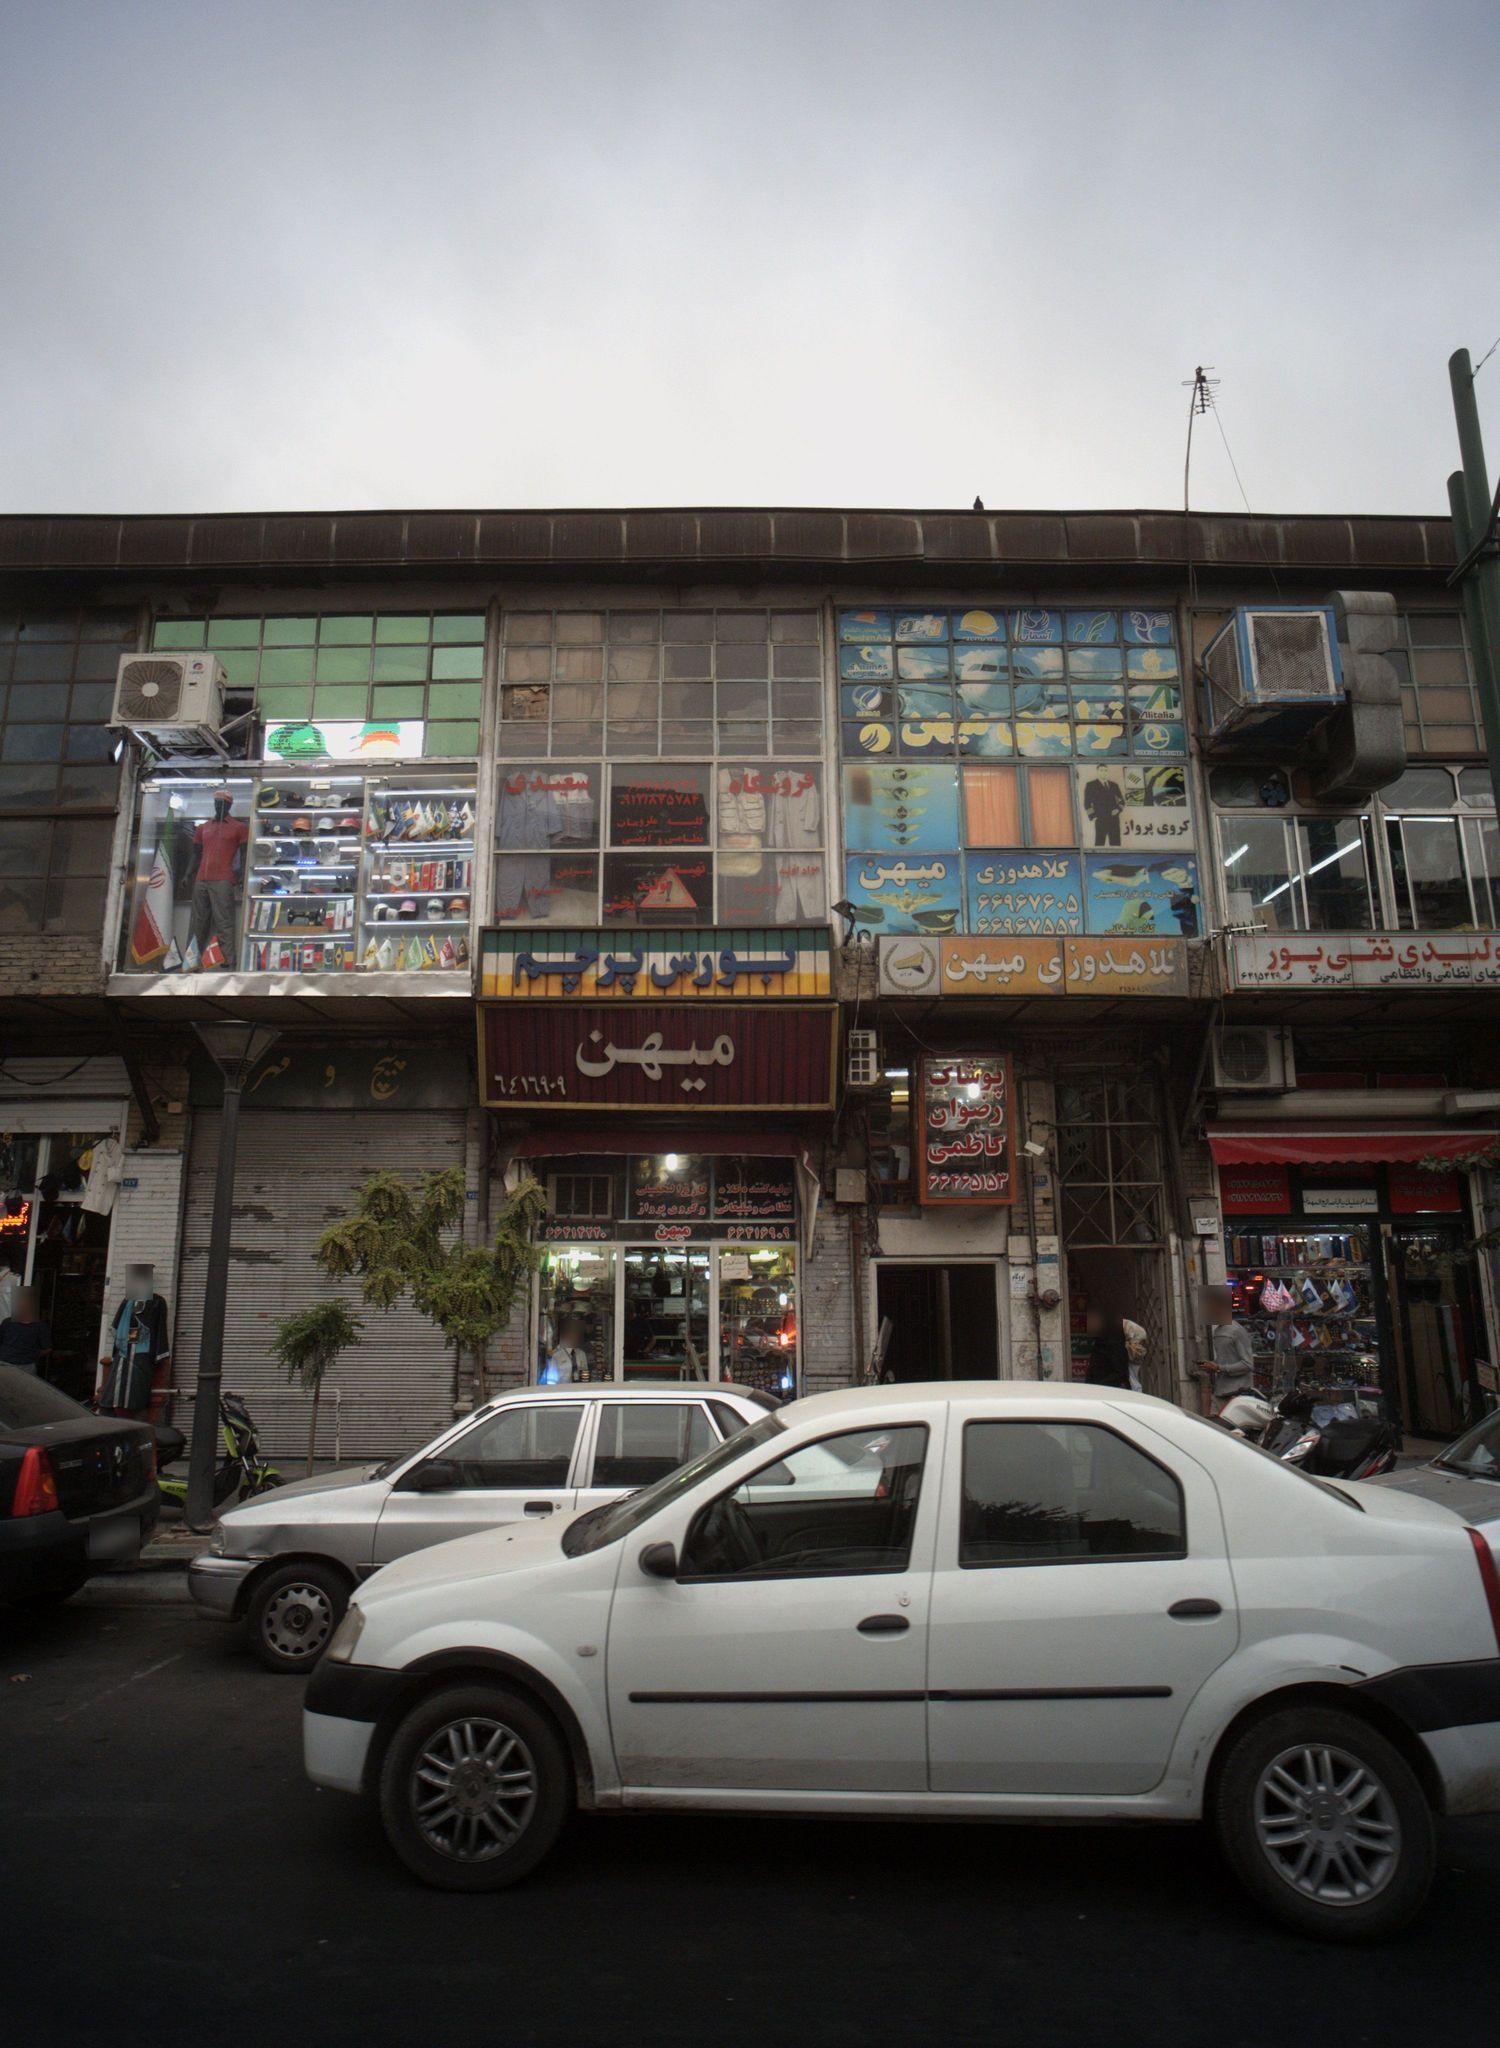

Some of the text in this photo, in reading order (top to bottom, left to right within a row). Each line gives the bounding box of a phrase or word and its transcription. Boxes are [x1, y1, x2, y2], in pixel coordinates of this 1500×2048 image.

[900, 700, 1125, 750] تولیدی میهن
[505, 772, 591, 797] سعیدی
[729, 768, 815, 798] فروشگاه
[1122, 818, 1191, 838] کروی پرواز
[858, 858, 947, 890] میهن
[976, 859, 1069, 885] کلاهدوزی
[976, 892, 1079, 914] ۶۶۹۶۷۶۰۵
[515, 945, 796, 994] بورس پرچم
[944, 950, 1025, 985] میهن
[1267, 940, 1323, 974] پور
[1327, 936, 1395, 971] تقی
[1433, 966, 1471, 982] نظامی
[575, 1028, 735, 1093] میهن
[929, 1060, 1005, 1100] پوشاک
[928, 1096, 1004, 1129] رضوان
[927, 1130, 1006, 1165] کاظمی
[927, 1173, 1009, 1192] ۶۶۴۶۵۱۵۳
[655, 1224, 692, 1241] میهن
